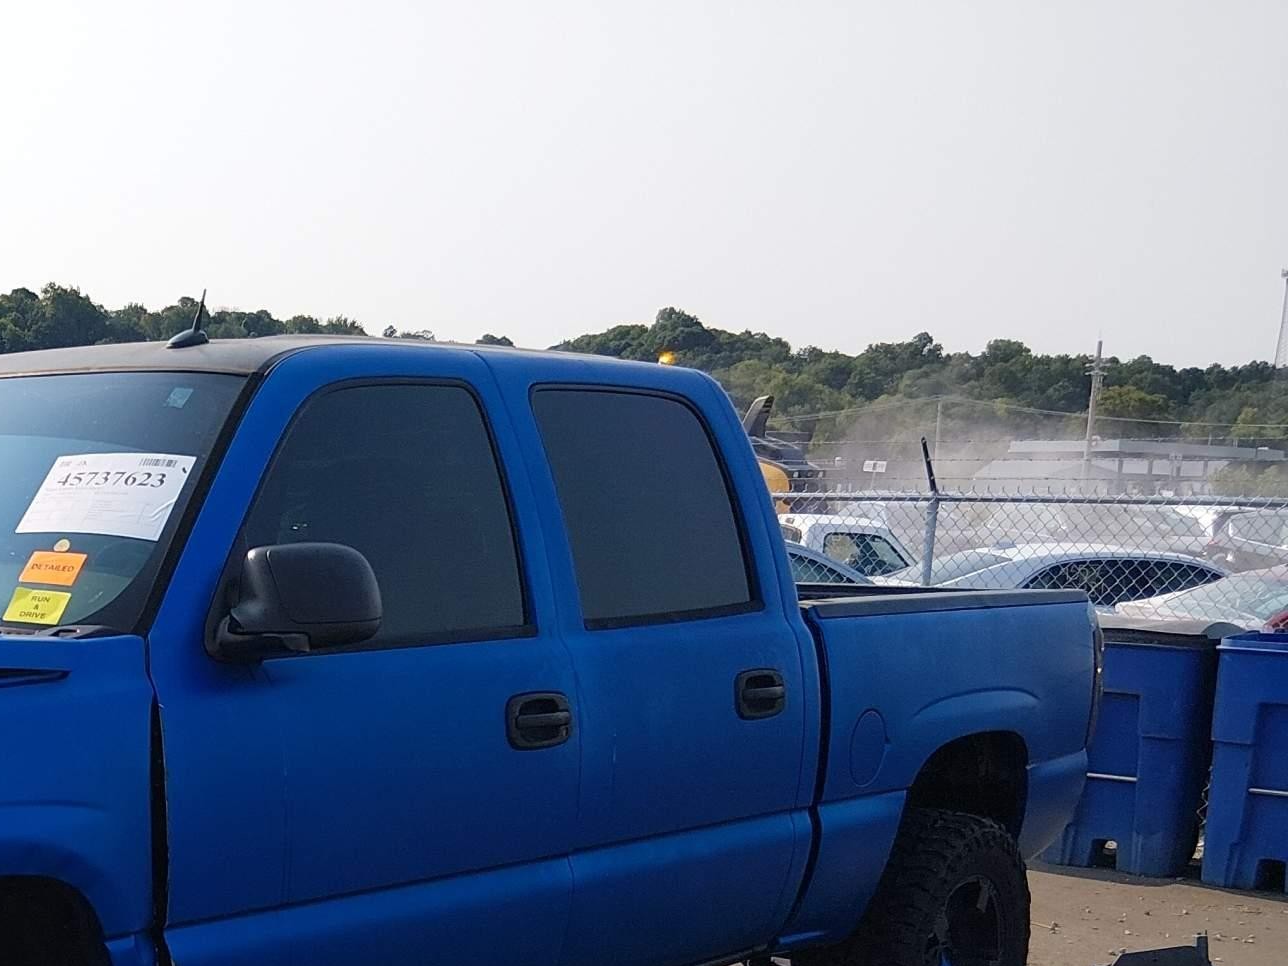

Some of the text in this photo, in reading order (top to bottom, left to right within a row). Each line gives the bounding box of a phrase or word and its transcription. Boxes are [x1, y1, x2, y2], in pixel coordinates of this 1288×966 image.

[57, 471, 166, 488] 45737623
[31, 563, 75, 573] DETAILED
[31, 595, 51, 603] RUN
[19, 610, 46, 619] DRIVE
